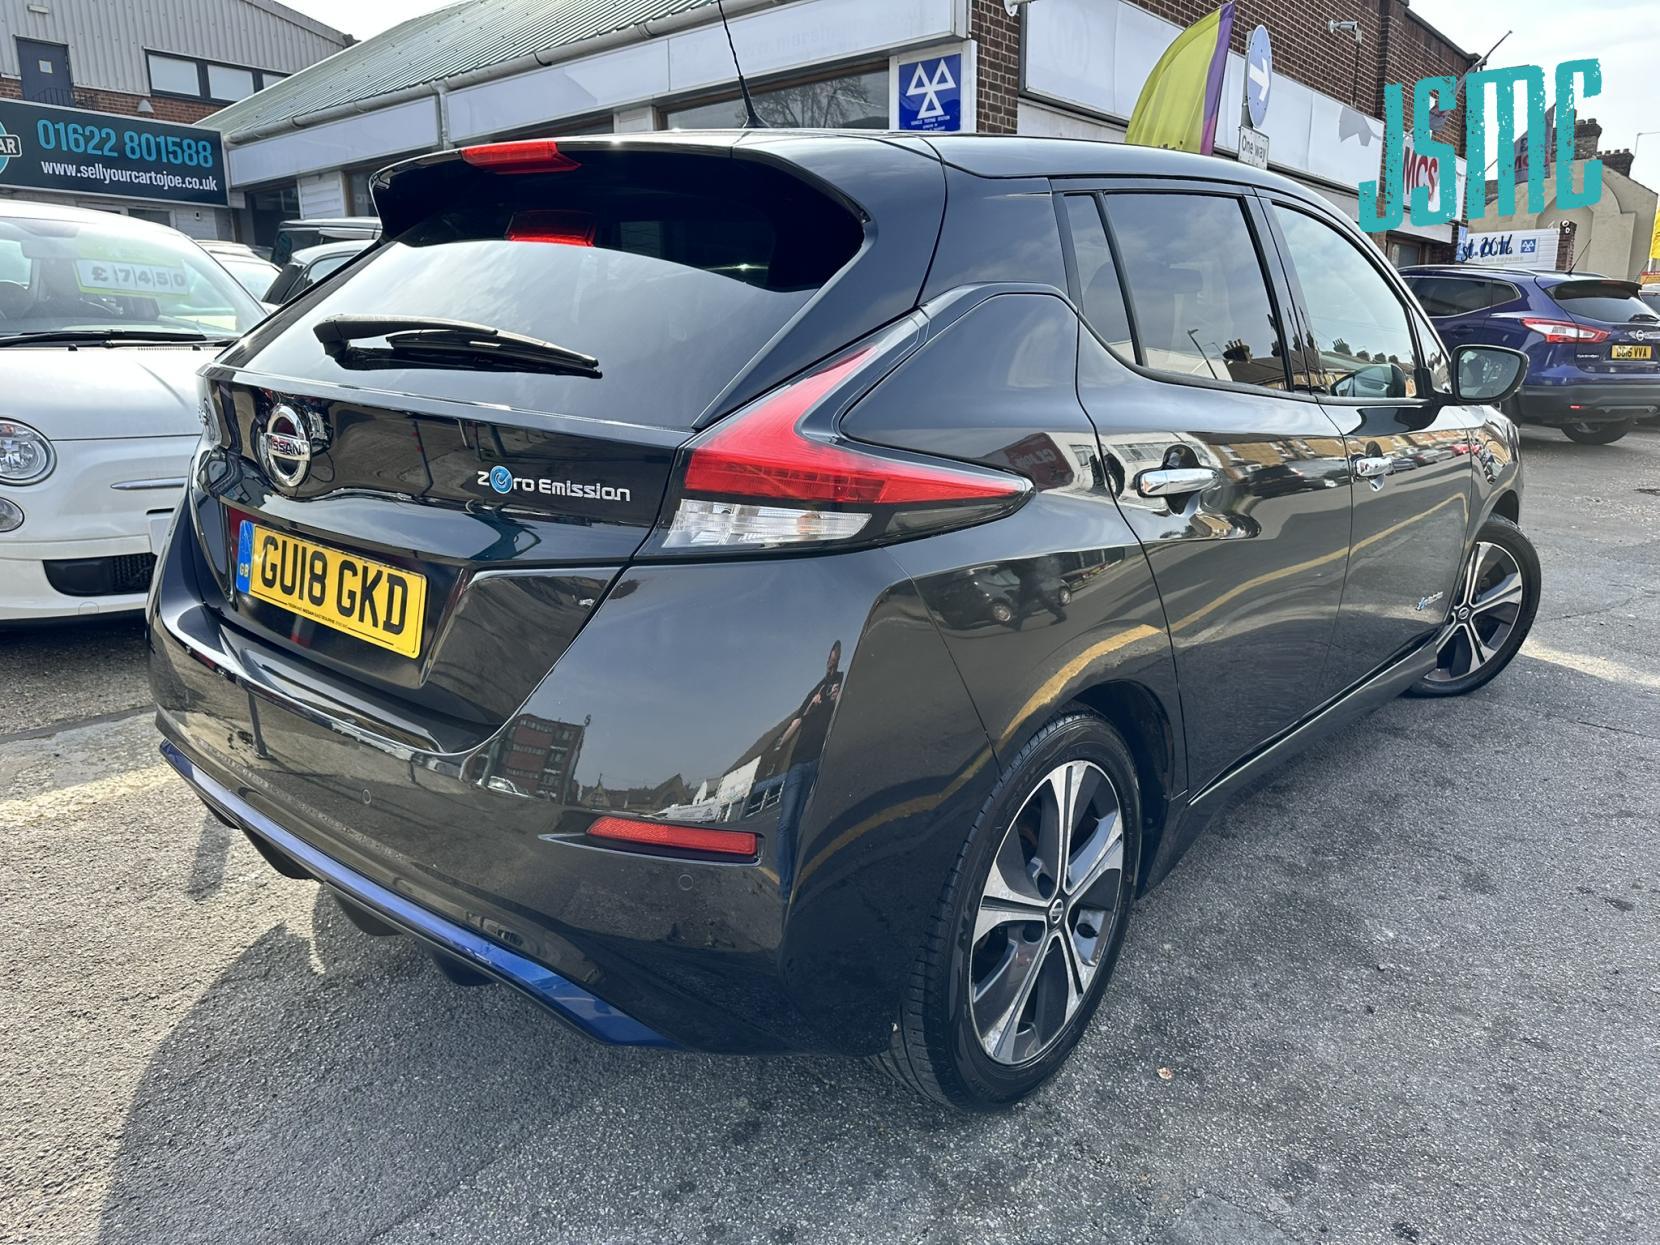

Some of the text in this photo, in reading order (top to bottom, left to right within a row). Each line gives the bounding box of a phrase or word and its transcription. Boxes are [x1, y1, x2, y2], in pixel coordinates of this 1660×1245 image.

[36, 119, 214, 168] 01622 801588
[1241, 135, 1253, 155] One
[40, 161, 218, 191] www.sellyourcartojoe.co.uk
[261, 535, 409, 635] GU18 GKD
